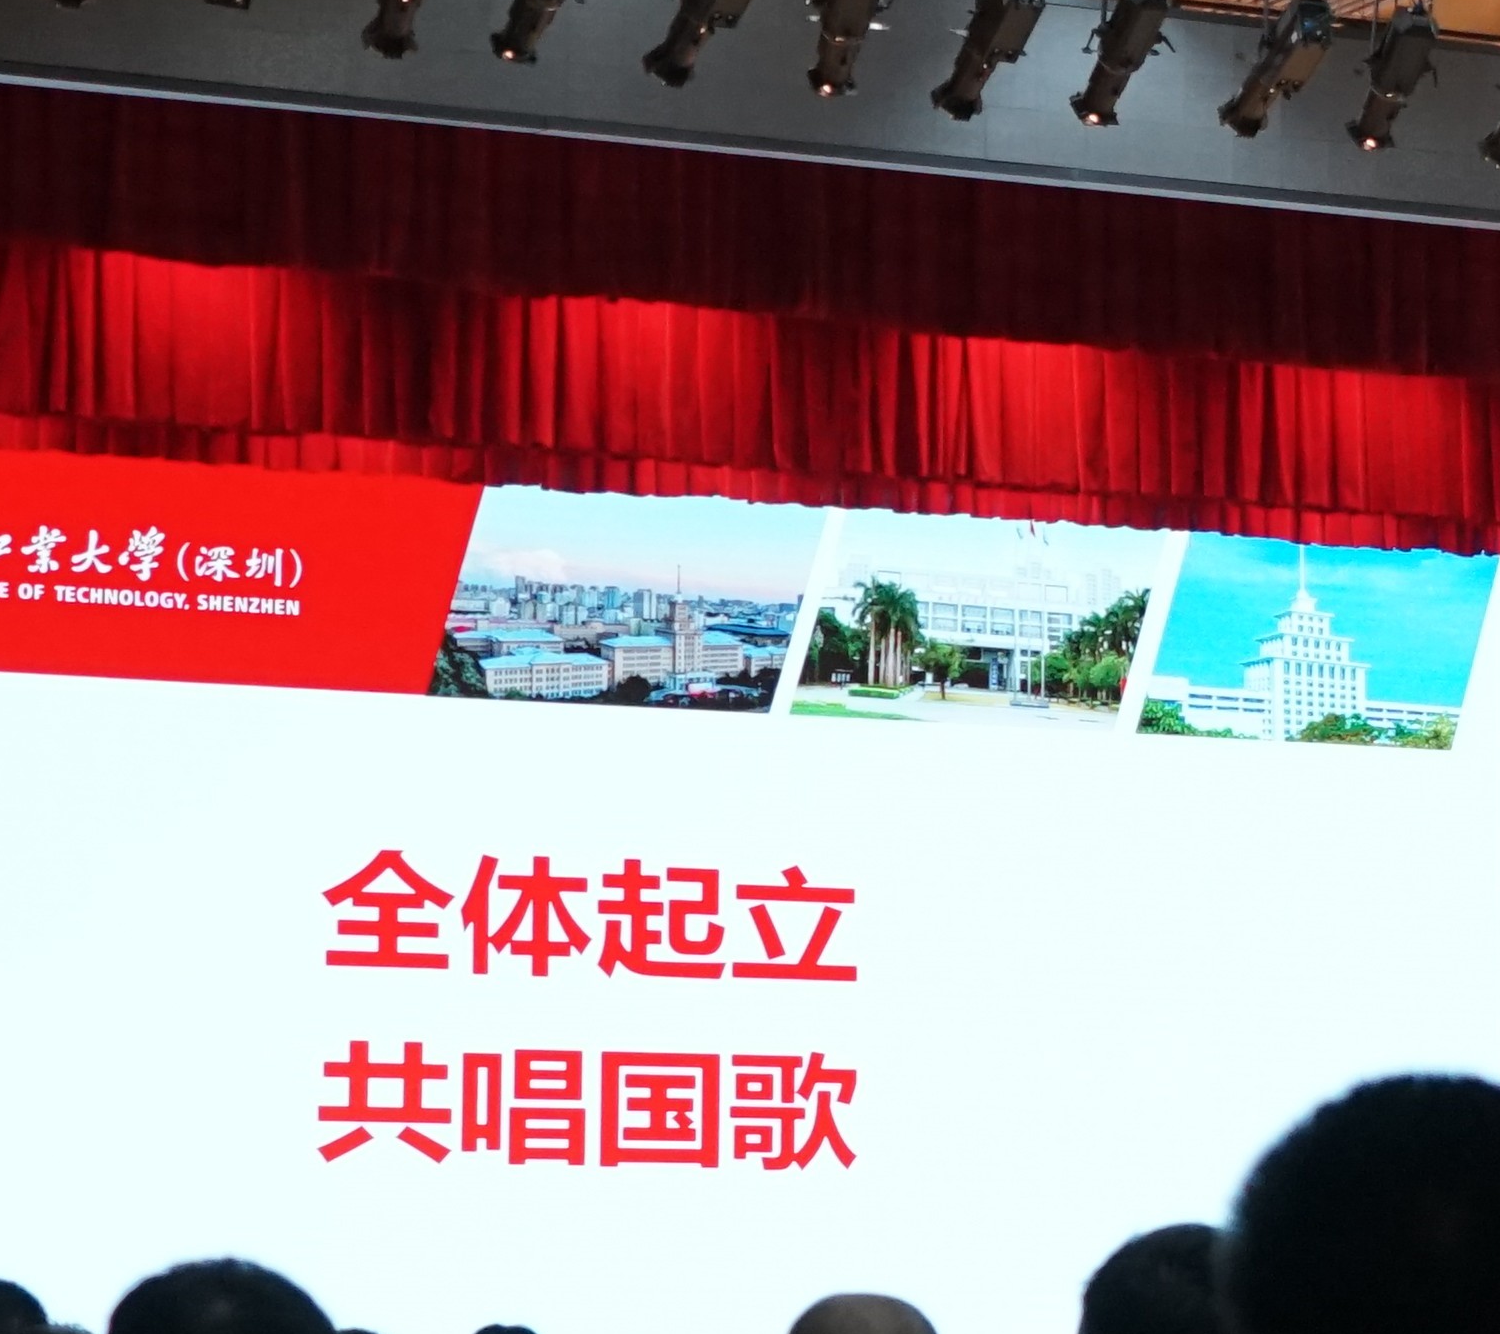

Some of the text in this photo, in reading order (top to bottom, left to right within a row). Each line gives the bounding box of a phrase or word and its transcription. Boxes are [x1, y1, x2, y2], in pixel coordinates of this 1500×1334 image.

[17, 582, 45, 600] OF
[197, 594, 300, 616] SHENZHEN
[323, 849, 857, 981] 全体起立
[318, 1040, 857, 1170] 共唱国歌
